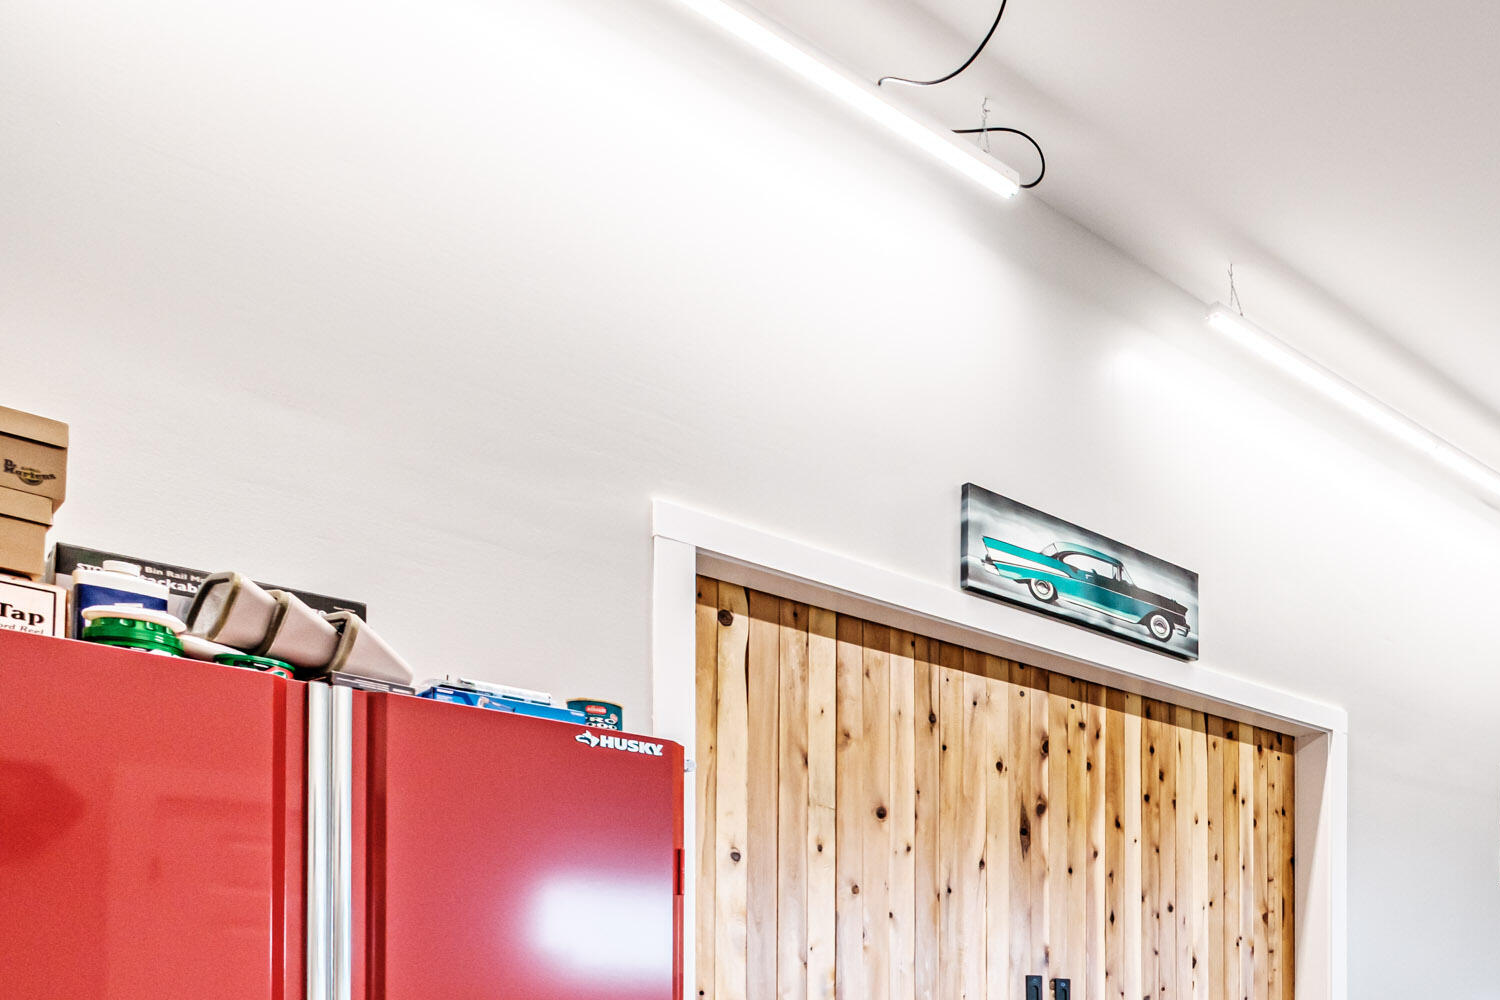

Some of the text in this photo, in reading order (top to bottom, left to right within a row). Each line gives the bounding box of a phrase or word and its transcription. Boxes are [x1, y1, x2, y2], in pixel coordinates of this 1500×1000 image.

[144, 566, 164, 576] Bin
[166, 570, 188, 580] Rail
[0, 602, 45, 626] Tap
[600, 734, 664, 756] HUSKY
